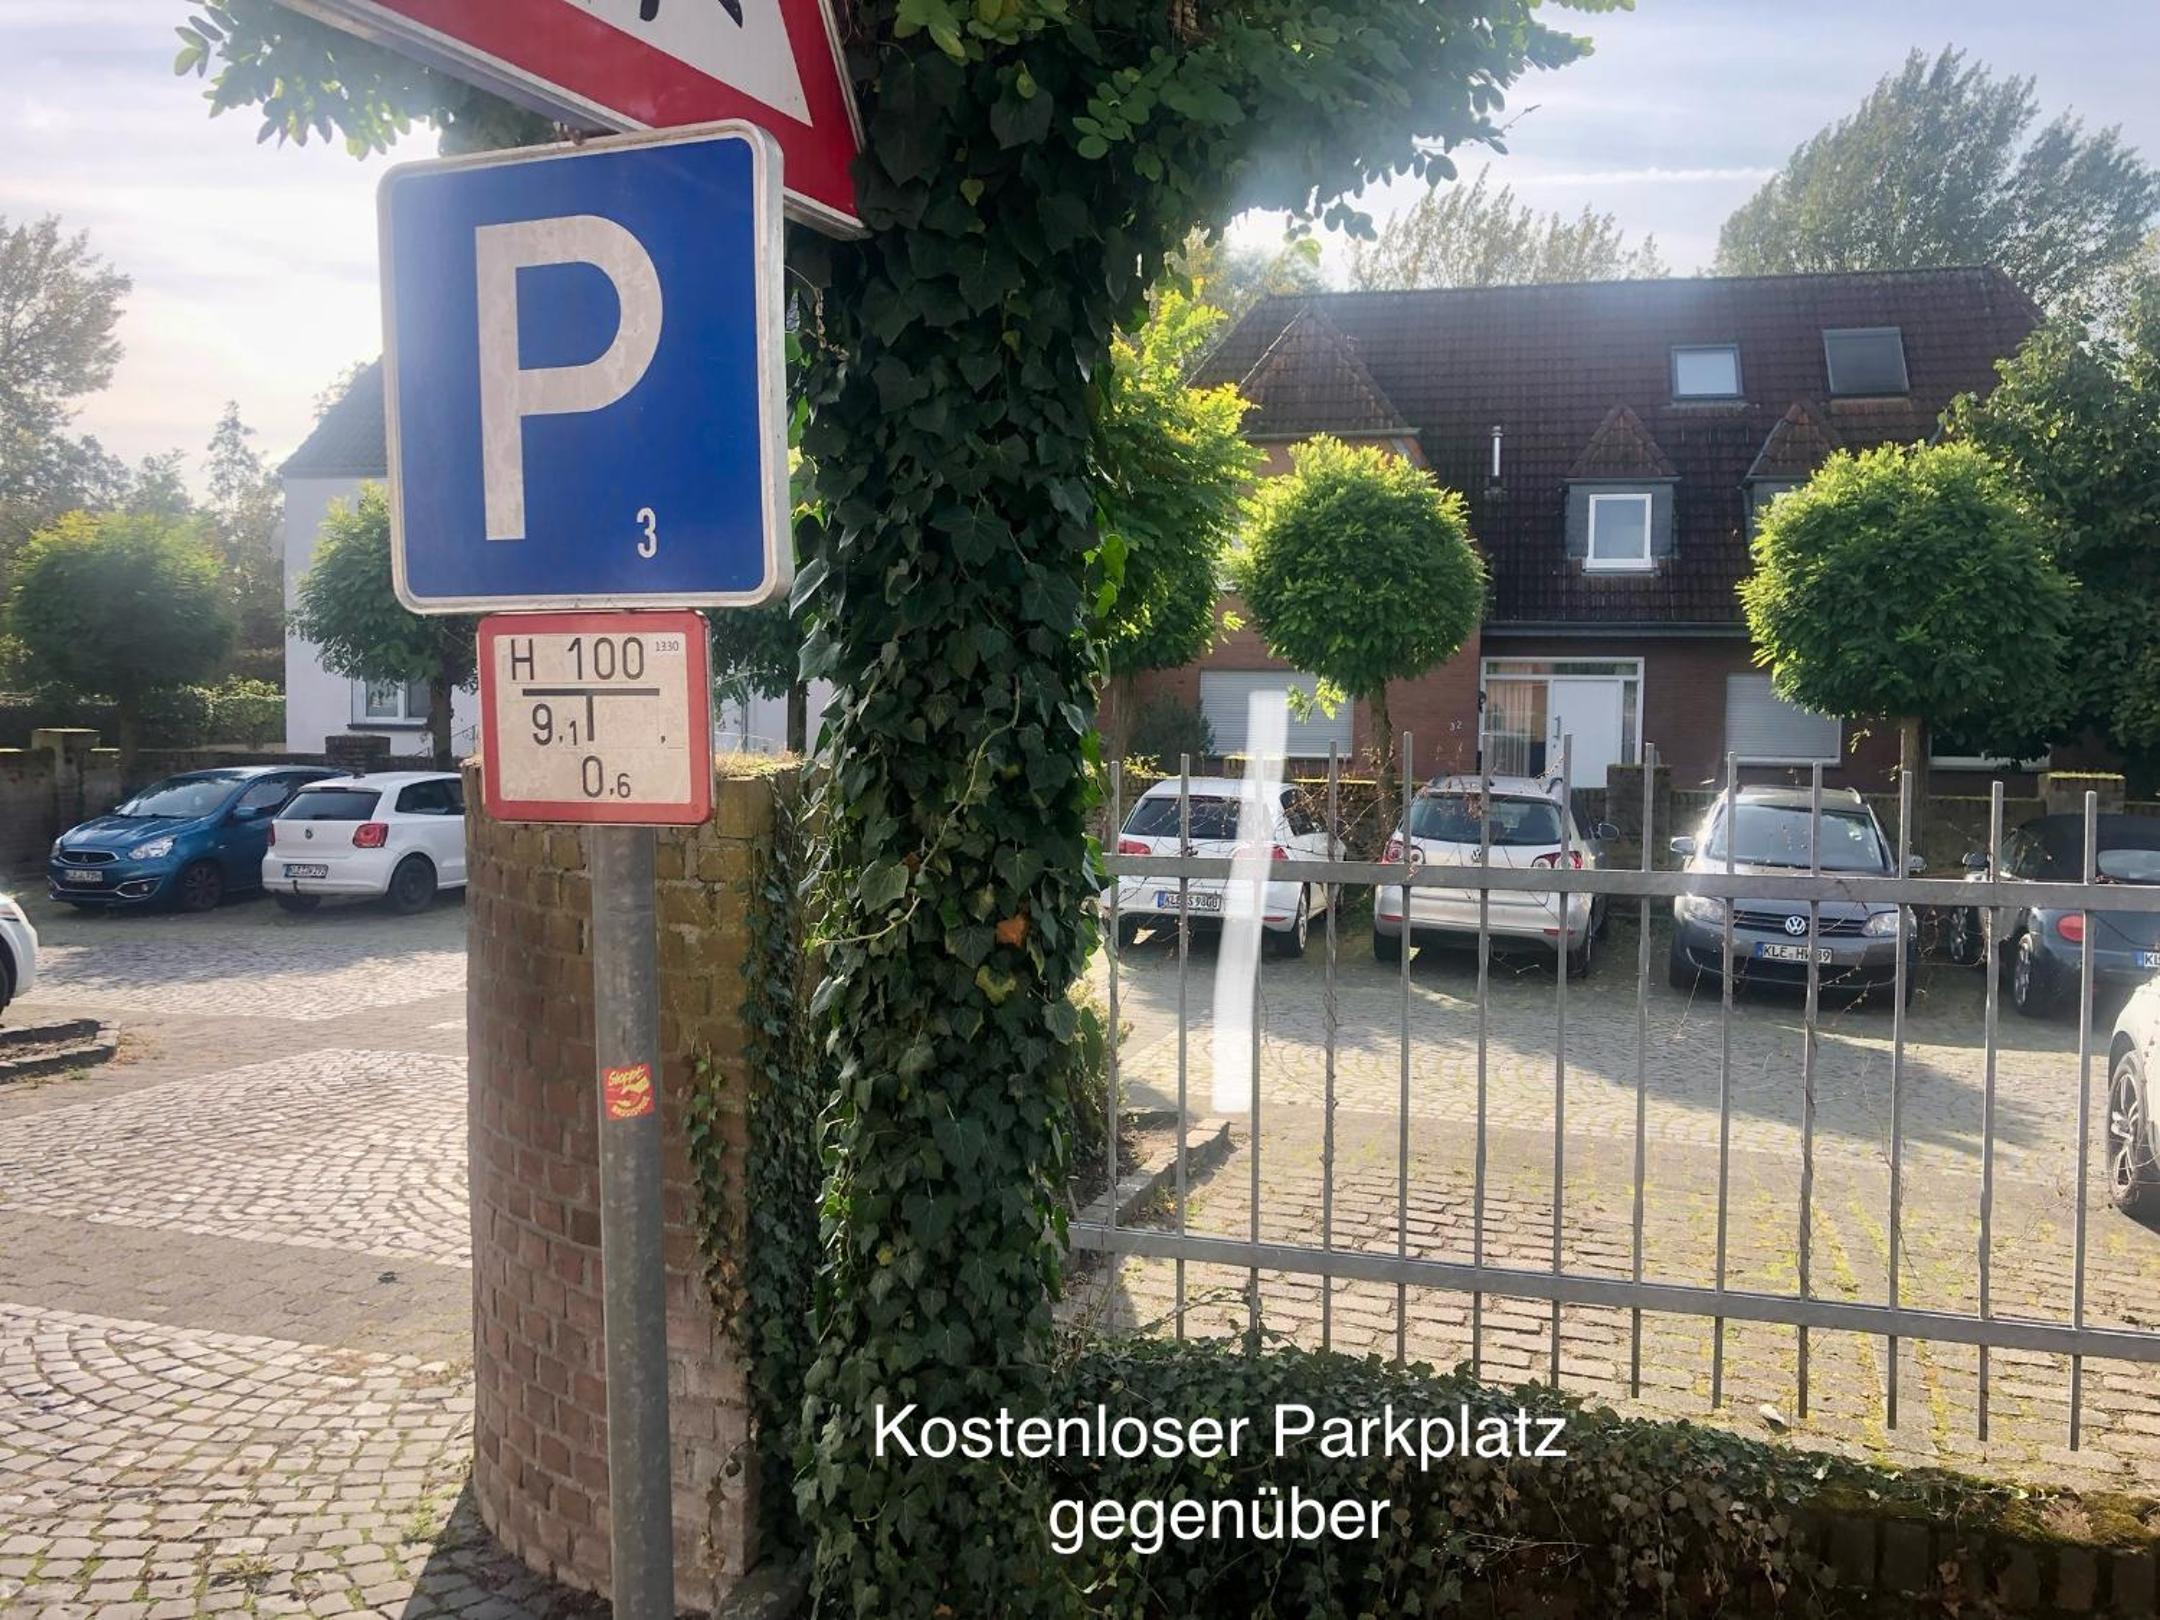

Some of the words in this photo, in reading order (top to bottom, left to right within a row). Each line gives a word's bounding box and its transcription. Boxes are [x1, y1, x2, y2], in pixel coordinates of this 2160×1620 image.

[474, 214, 664, 542] P
[635, 507, 659, 559] 3
[510, 638, 535, 680] H
[567, 636, 645, 681] 100
[655, 639, 679, 652] 1330
[1763, 945, 1788, 958] KLE
